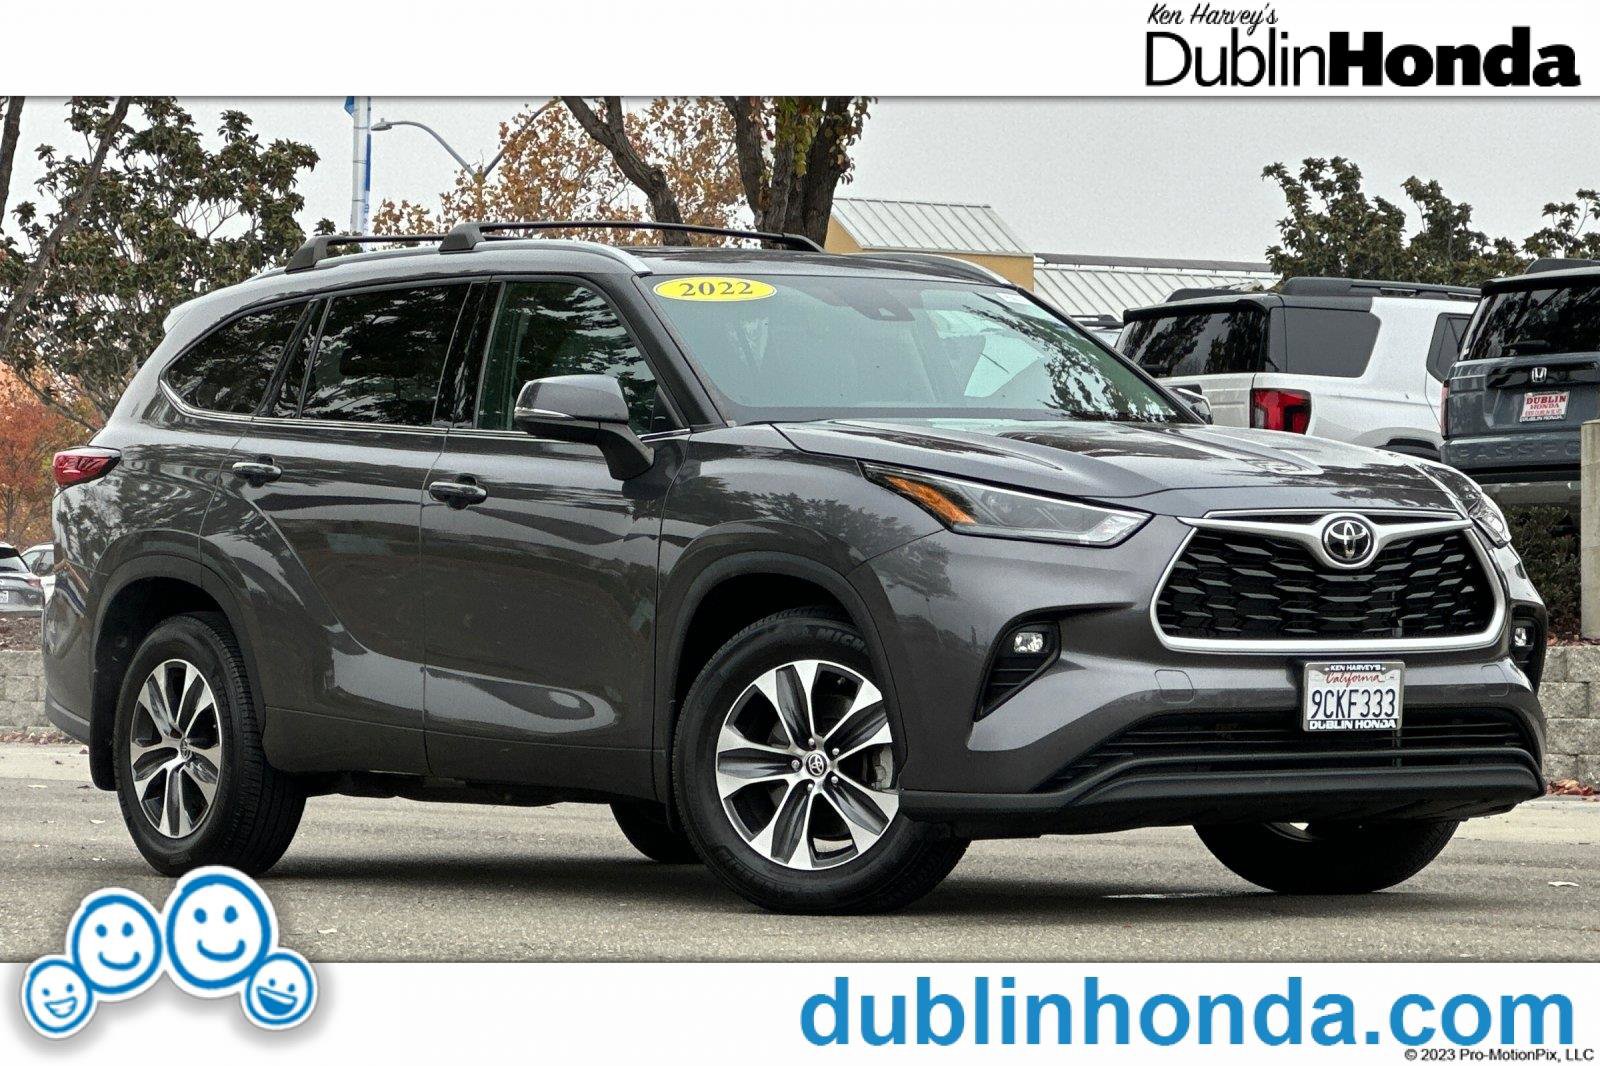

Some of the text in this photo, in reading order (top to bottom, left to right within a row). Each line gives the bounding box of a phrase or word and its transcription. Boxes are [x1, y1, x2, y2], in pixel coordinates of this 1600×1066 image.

[679, 281, 753, 297] 2022
[1526, 396, 1567, 405] DUBLIN
[1325, 672, 1386, 687] California
[1310, 688, 1396, 719] 9CKF333
[1309, 719, 1396, 729] DUBLIN HONDA
